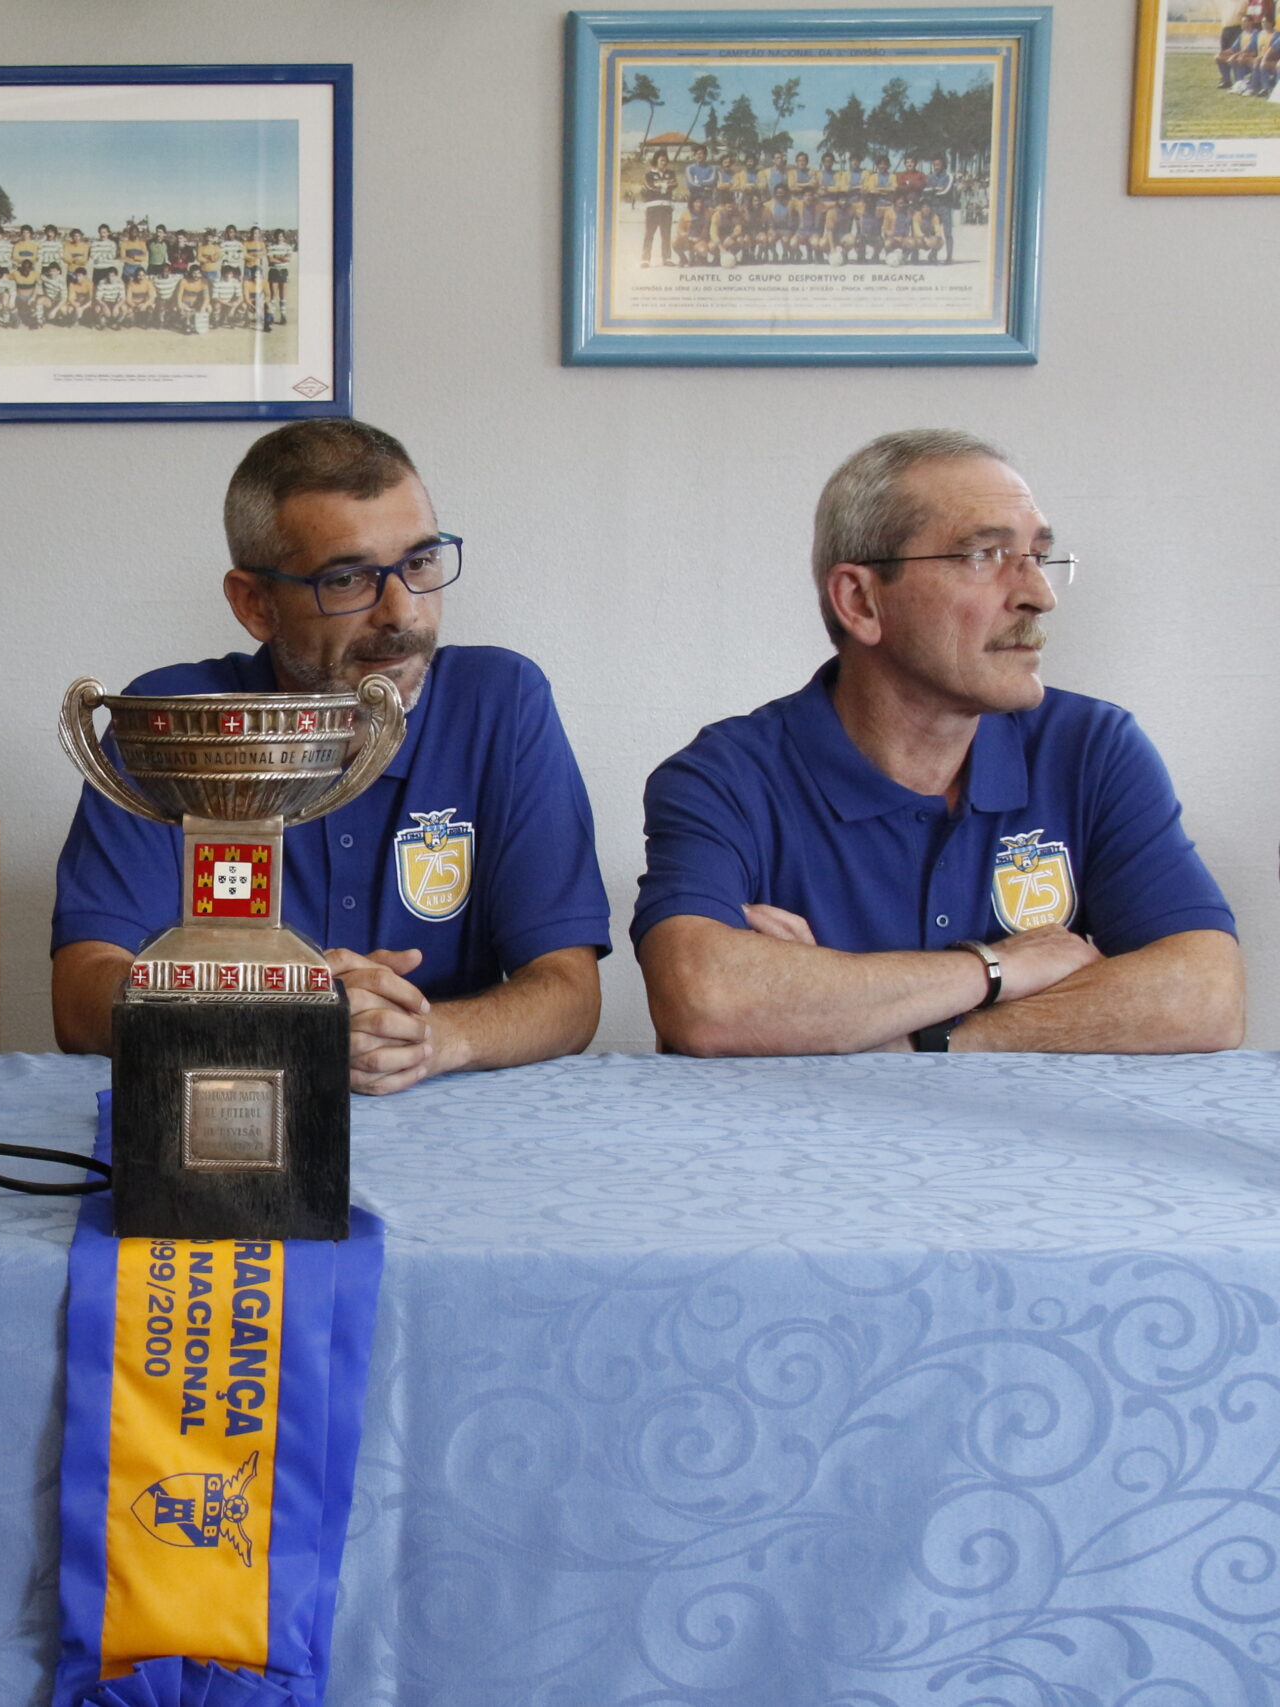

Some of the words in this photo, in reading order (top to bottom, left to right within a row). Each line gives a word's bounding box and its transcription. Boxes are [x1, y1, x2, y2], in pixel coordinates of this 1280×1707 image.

[1160, 141, 1215, 160] VDB
[679, 274, 721, 282] PLANTEL
[728, 274, 742, 282] DO
[748, 274, 782, 282] GRUPO
[788, 274, 846, 282] DESPORTIVO
[853, 274, 865, 282] DE
[871, 274, 925, 284] BRAGANÇA
[203, 750, 275, 766] NACIONAL
[280, 750, 296, 765] DE
[415, 850, 460, 906] 75
[426, 893, 454, 907] ANOS
[1007, 869, 1061, 927] 75
[1025, 913, 1056, 927] ANOS
[180, 1251, 214, 1435] NACIONAL
[203, 1476, 220, 1544] G.D.B.
